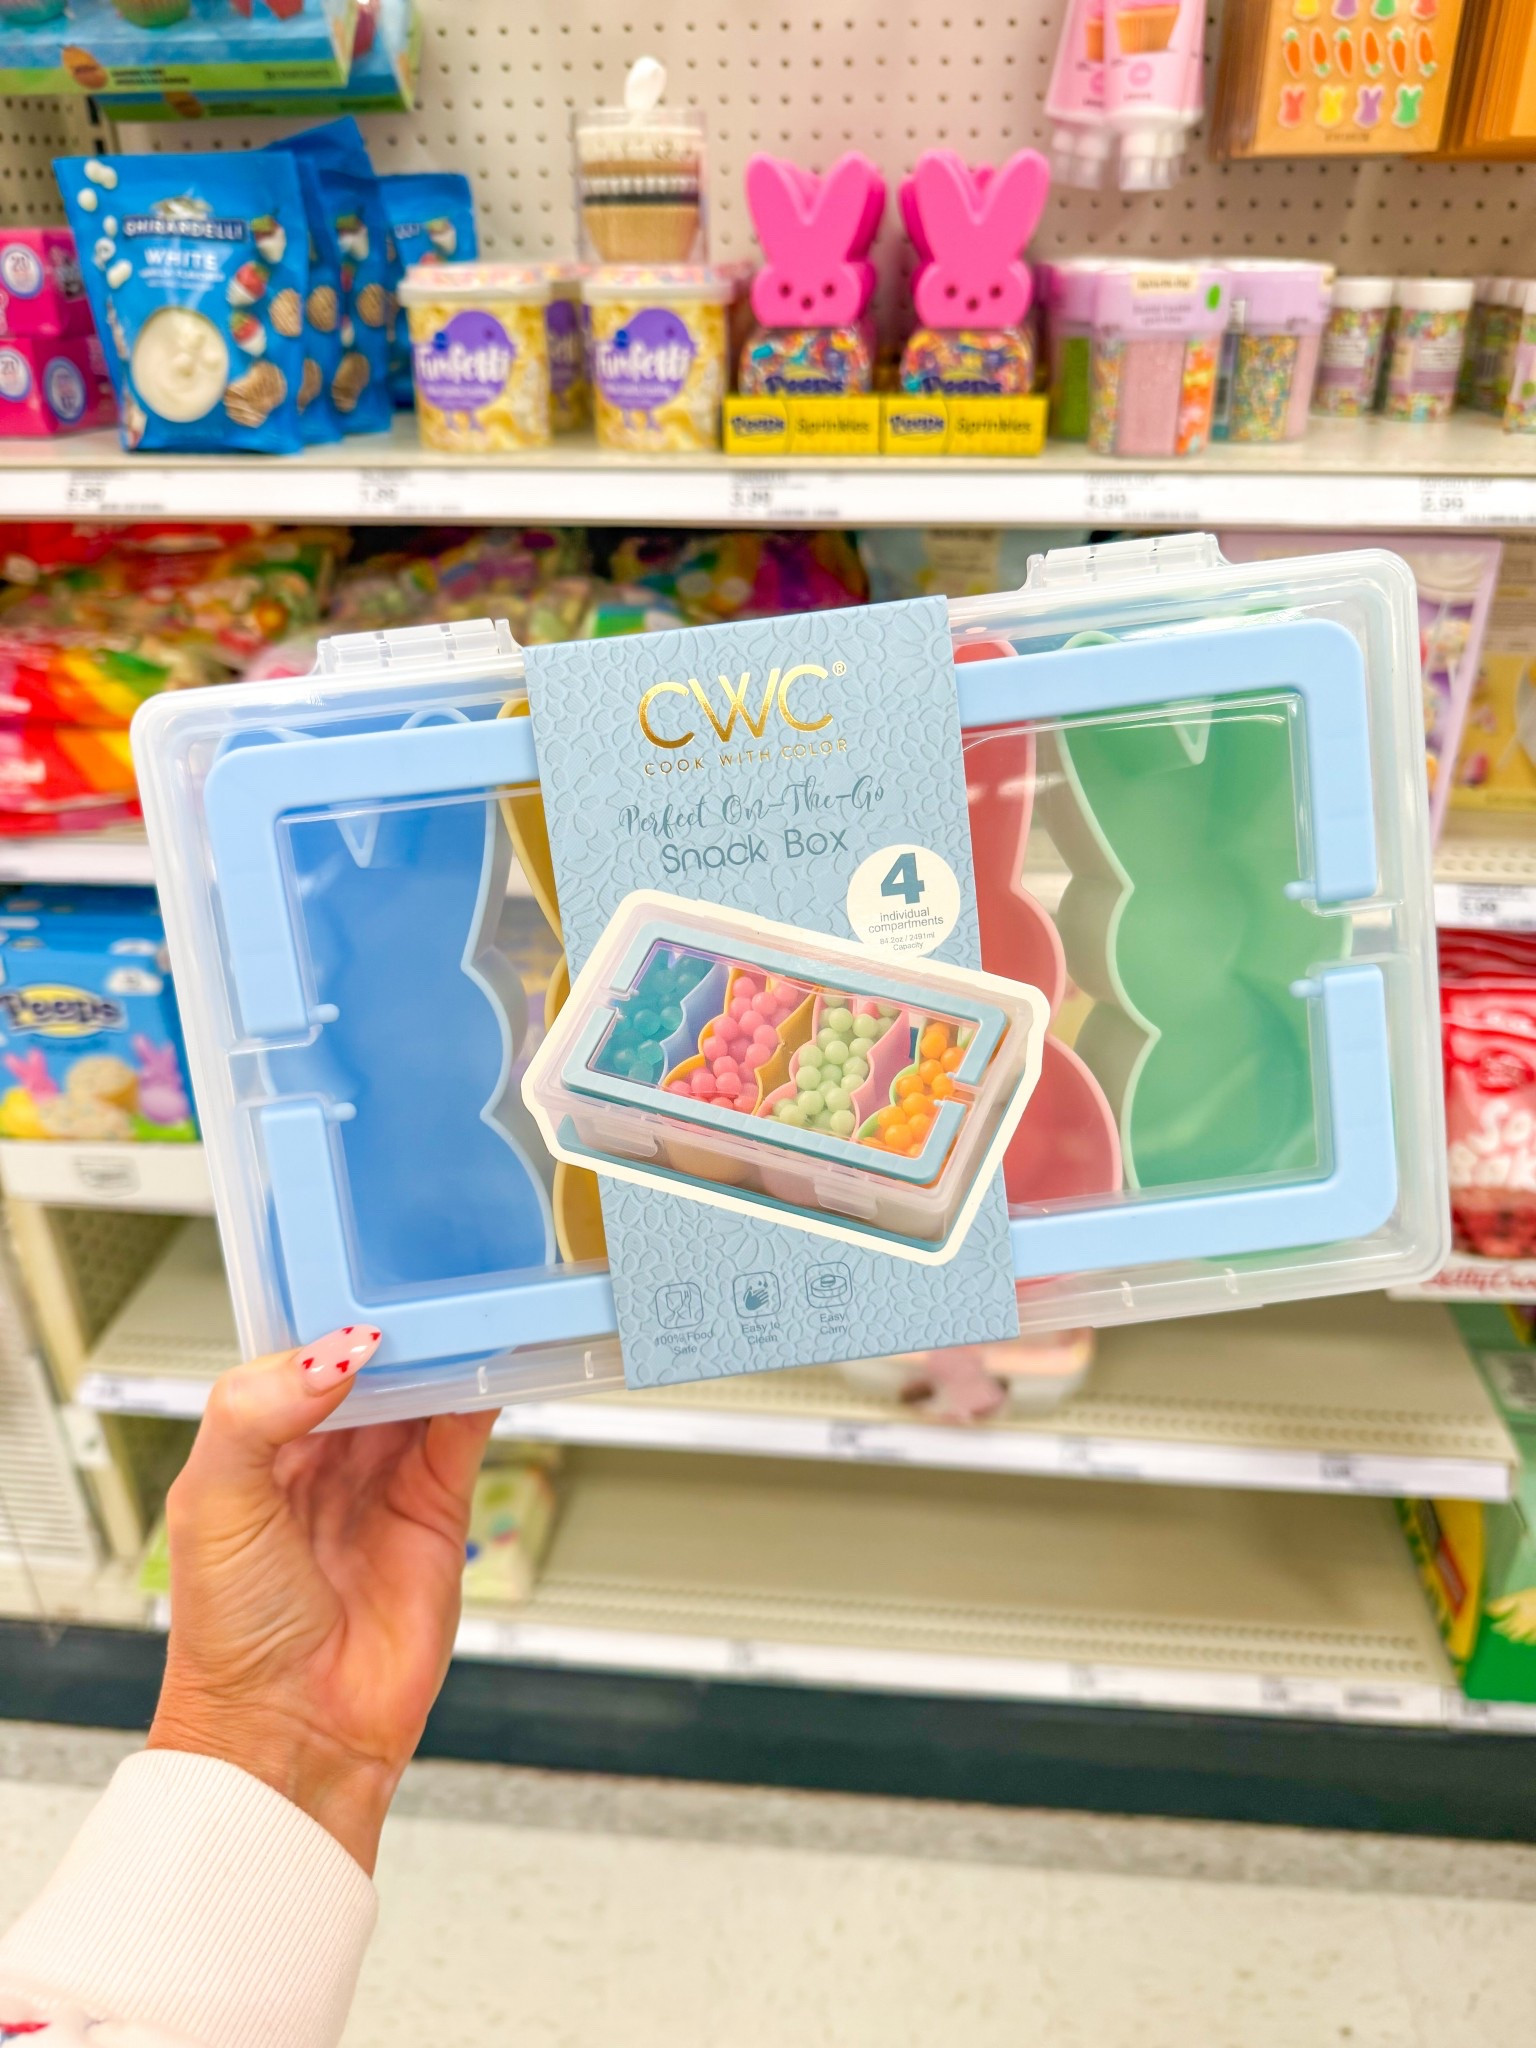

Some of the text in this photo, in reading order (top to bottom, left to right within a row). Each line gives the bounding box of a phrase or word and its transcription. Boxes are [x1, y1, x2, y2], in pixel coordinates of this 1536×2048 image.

[144, 248, 218, 271] WHITE
[798, 418, 870, 437] Sprinkles
[957, 417, 1031, 436] Sprinkles
[644, 738, 848, 777] COOK WITH COLOR
[618, 775, 885, 840] Perfect On-The-Go
[662, 828, 849, 875] Snack Box
[880, 852, 926, 906] 4
[880, 906, 930, 923] individual
[868, 916, 944, 933] compartments
[879, 936, 904, 945] 84.2oz
[909, 931, 935, 942] 2491ml
[892, 941, 924, 951] Capacity
[0, 993, 122, 1029] Peeps
[820, 1311, 846, 1324] Easy
[741, 1321, 781, 1336] Easy to
[819, 1323, 849, 1336] Carry
[655, 1330, 714, 1347] 100% Food
[747, 1333, 778, 1346] Clean
[673, 1344, 698, 1356] Safe
